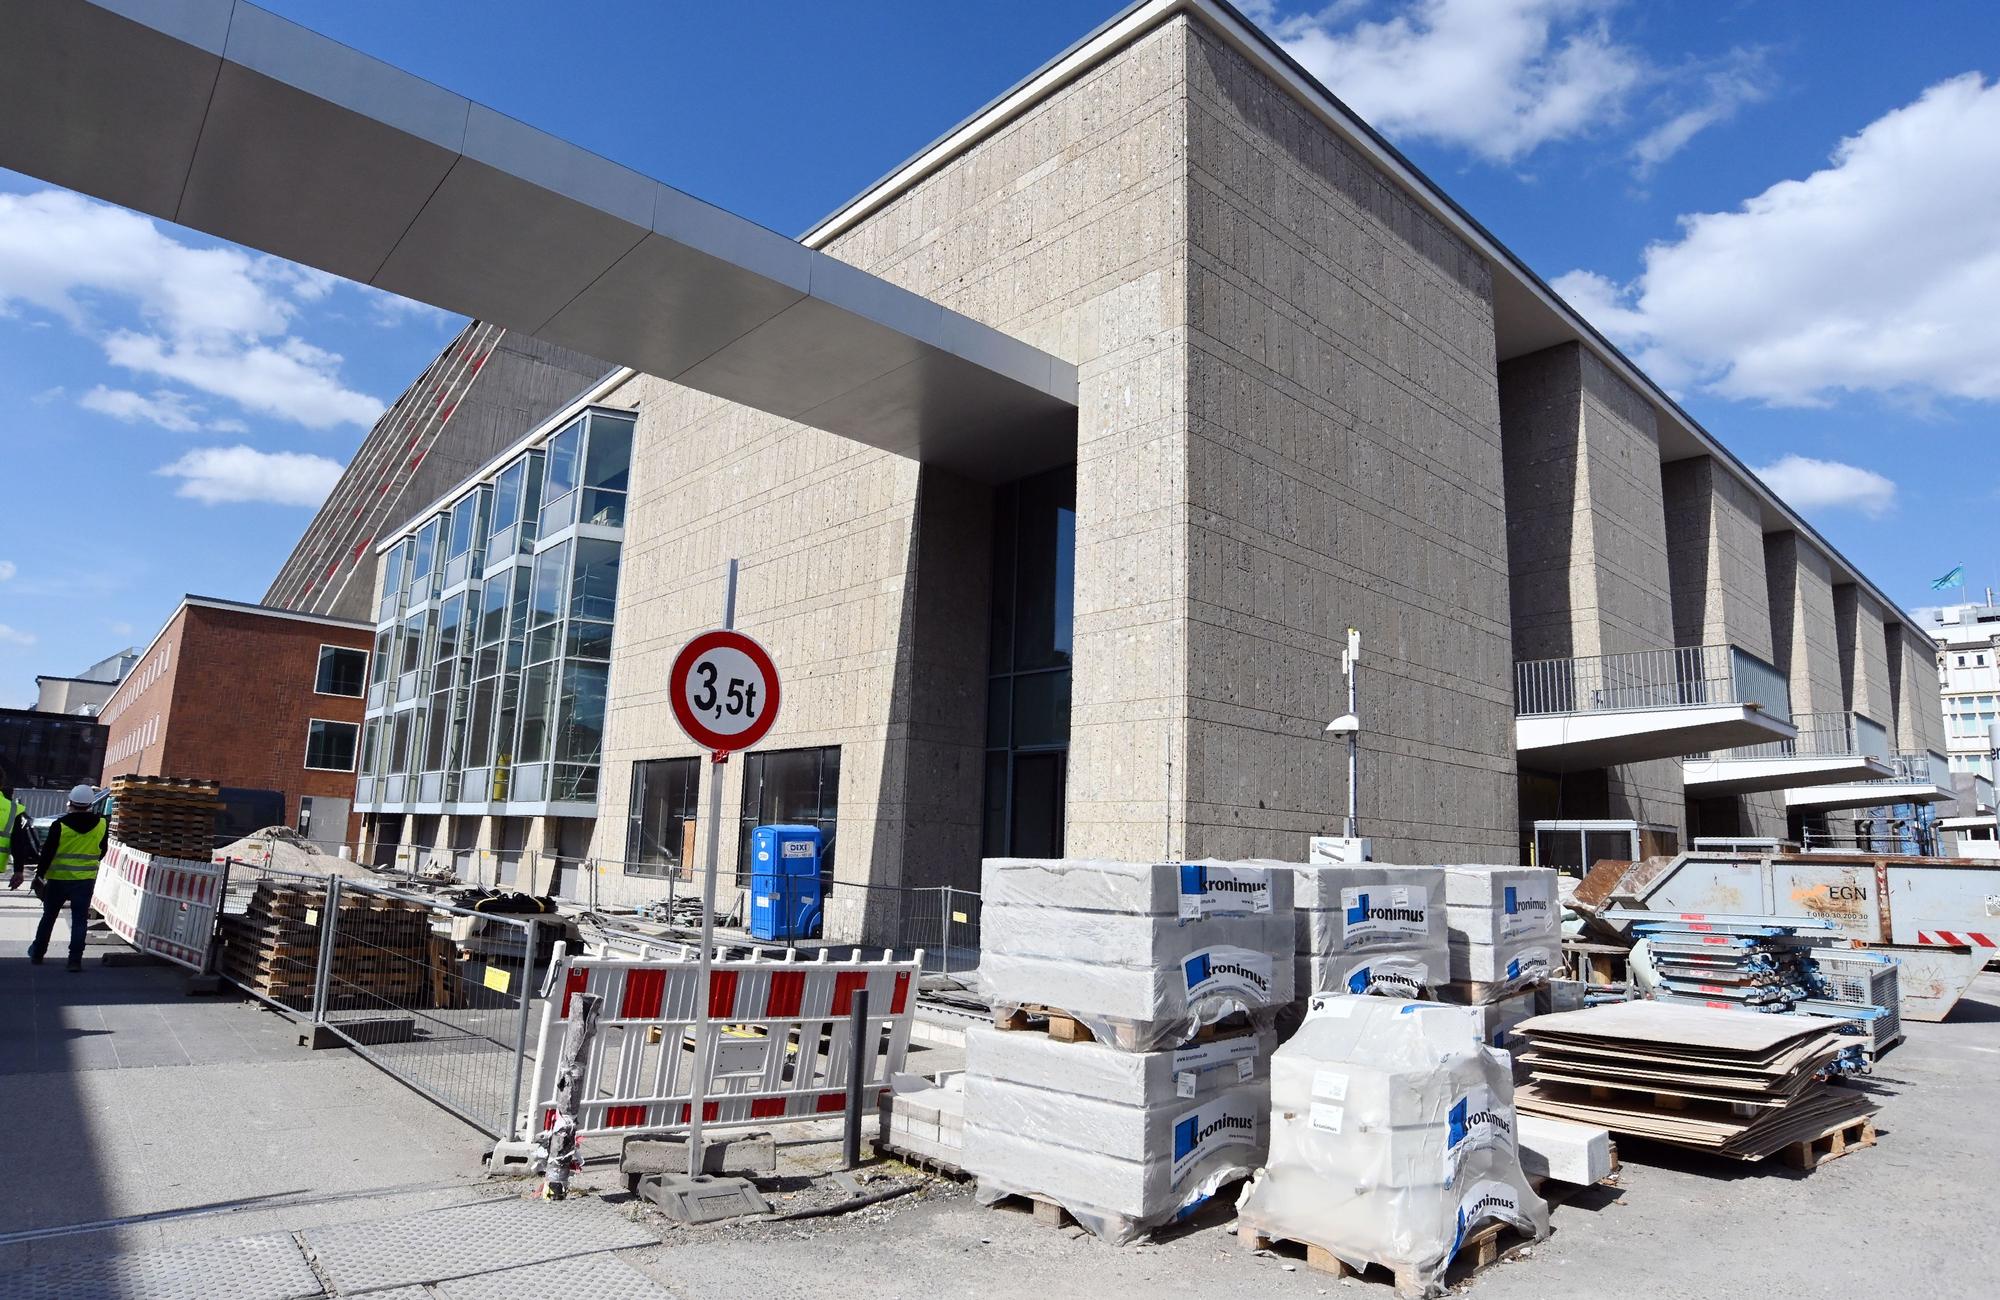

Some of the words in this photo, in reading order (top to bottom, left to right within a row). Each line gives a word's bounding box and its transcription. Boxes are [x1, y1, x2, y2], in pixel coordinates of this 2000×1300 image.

[693, 661, 757, 719] 3,5t
[1199, 866, 1267, 893] kronimus
[1829, 886, 1867, 901] EGN
[1362, 896, 1424, 922] kronimus
[1202, 957, 1267, 992] kronimus
[1191, 1112, 1253, 1148] kronimus
